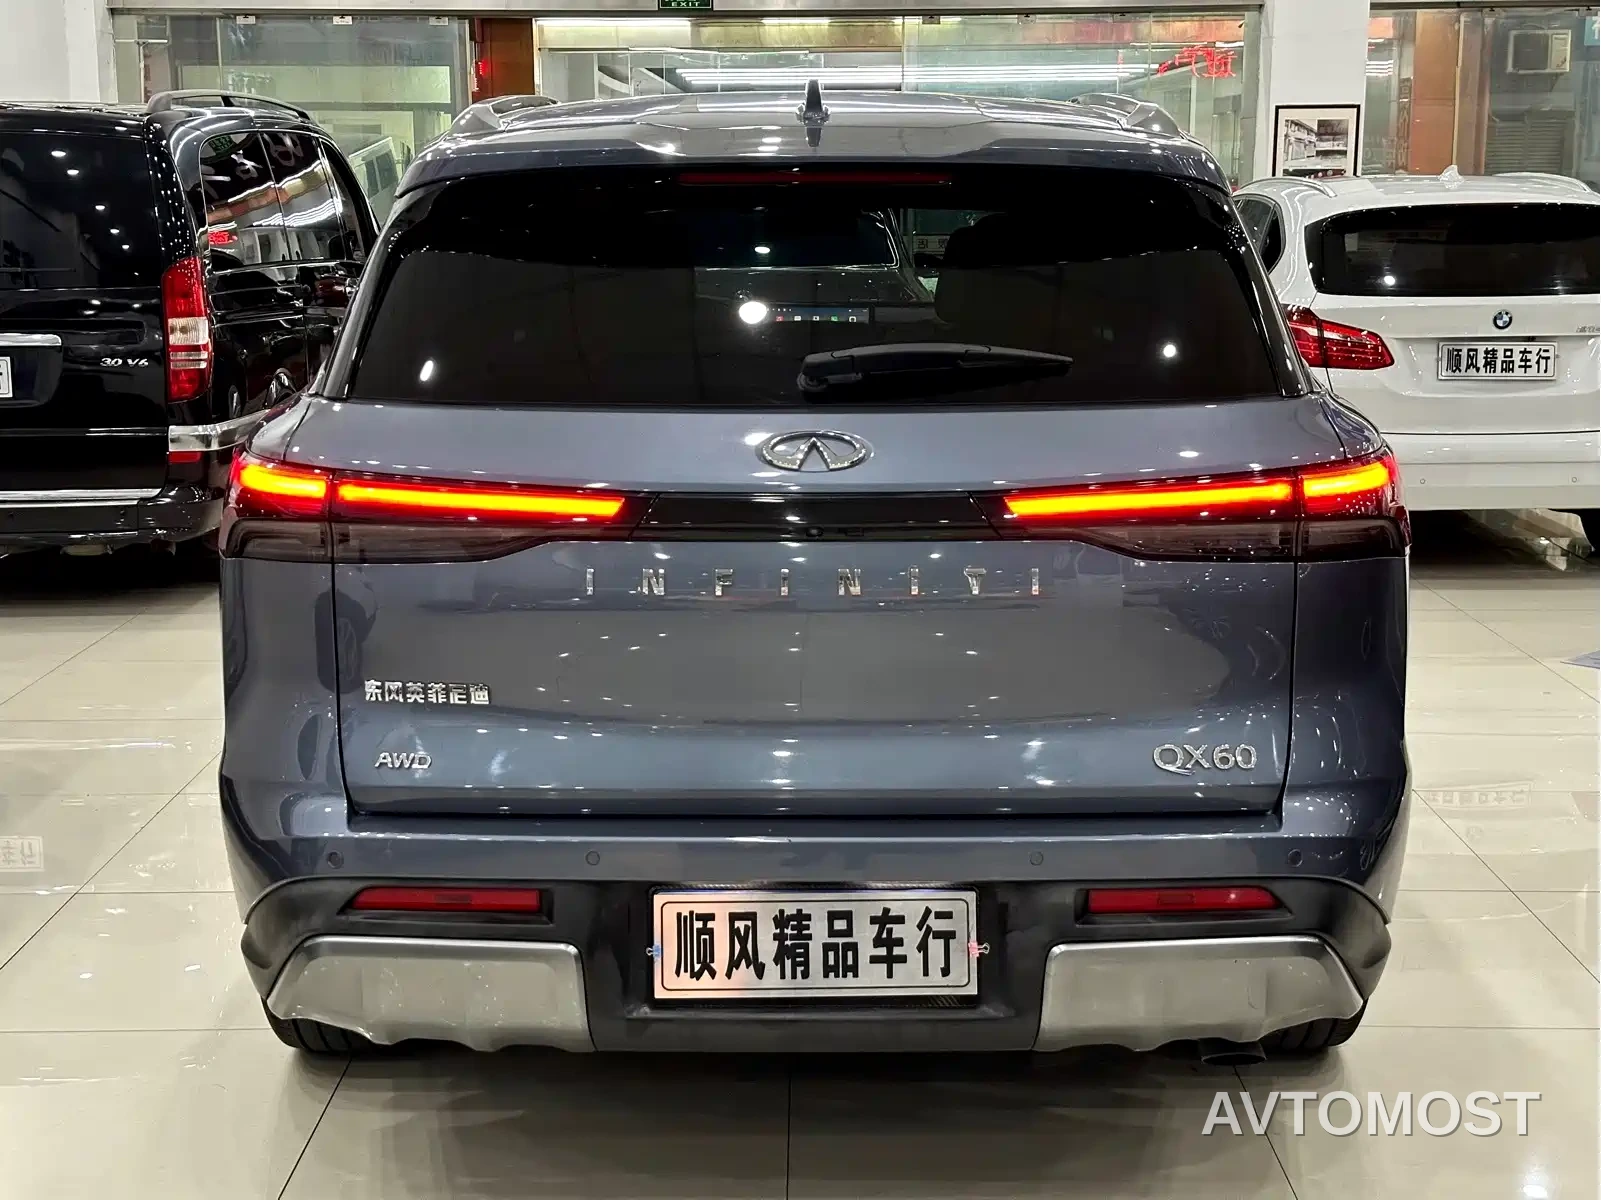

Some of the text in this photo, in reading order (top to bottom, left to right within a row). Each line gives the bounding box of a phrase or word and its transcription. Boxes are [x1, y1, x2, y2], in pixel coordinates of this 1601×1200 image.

[127, 358, 149, 367] V6
[1446, 347, 1551, 374] 顺风精品车行
[586, 568, 1040, 596] INFINITI
[364, 679, 490, 705] 东风英菲尼迪
[374, 752, 432, 769] AWD
[1153, 744, 1257, 776] QX60
[675, 906, 956, 981] 顺风精品车行
